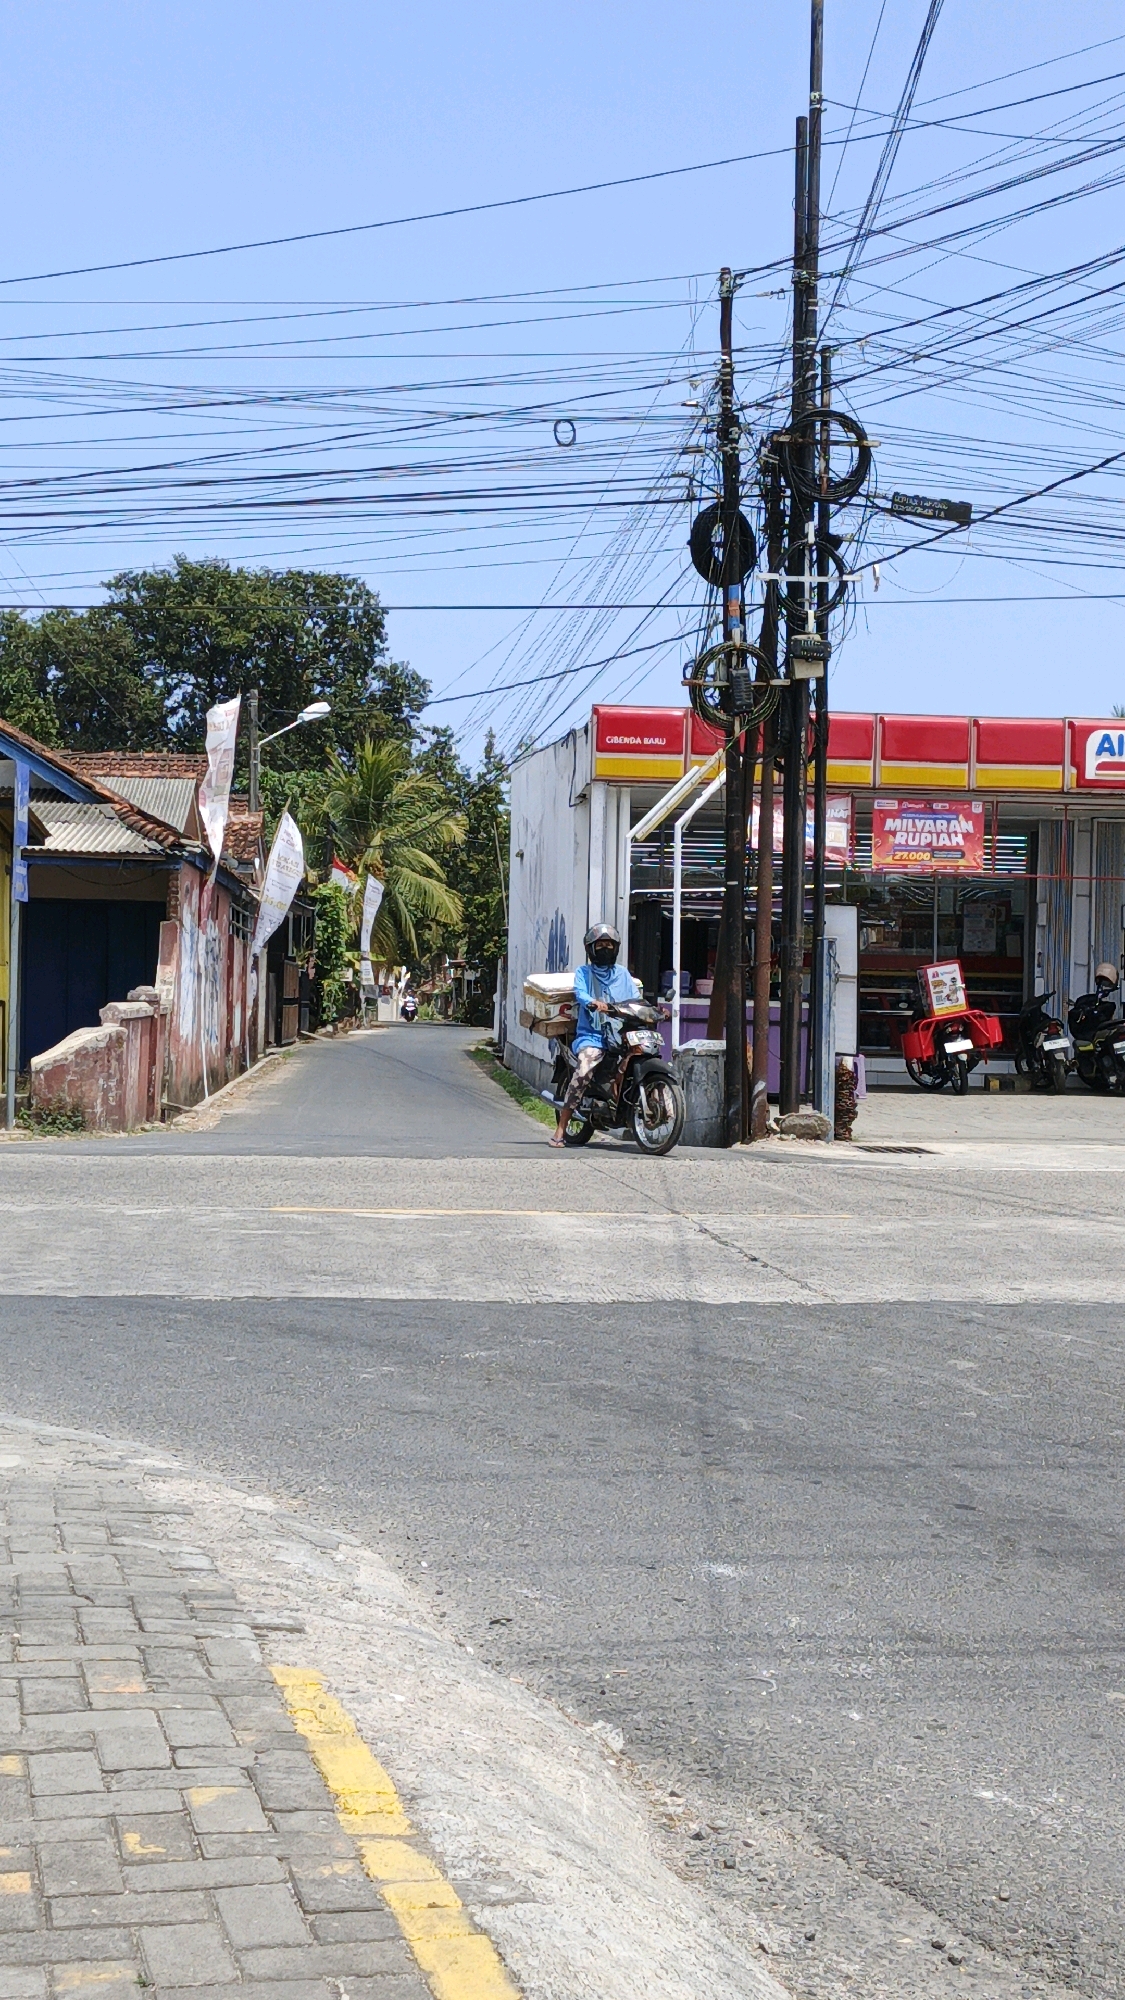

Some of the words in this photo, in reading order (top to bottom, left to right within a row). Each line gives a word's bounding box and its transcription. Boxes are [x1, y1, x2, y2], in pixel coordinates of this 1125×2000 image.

[884, 818, 974, 833] MILYARAN
[894, 831, 965, 846] RUPIAH
[893, 851, 931, 860] 27.000
